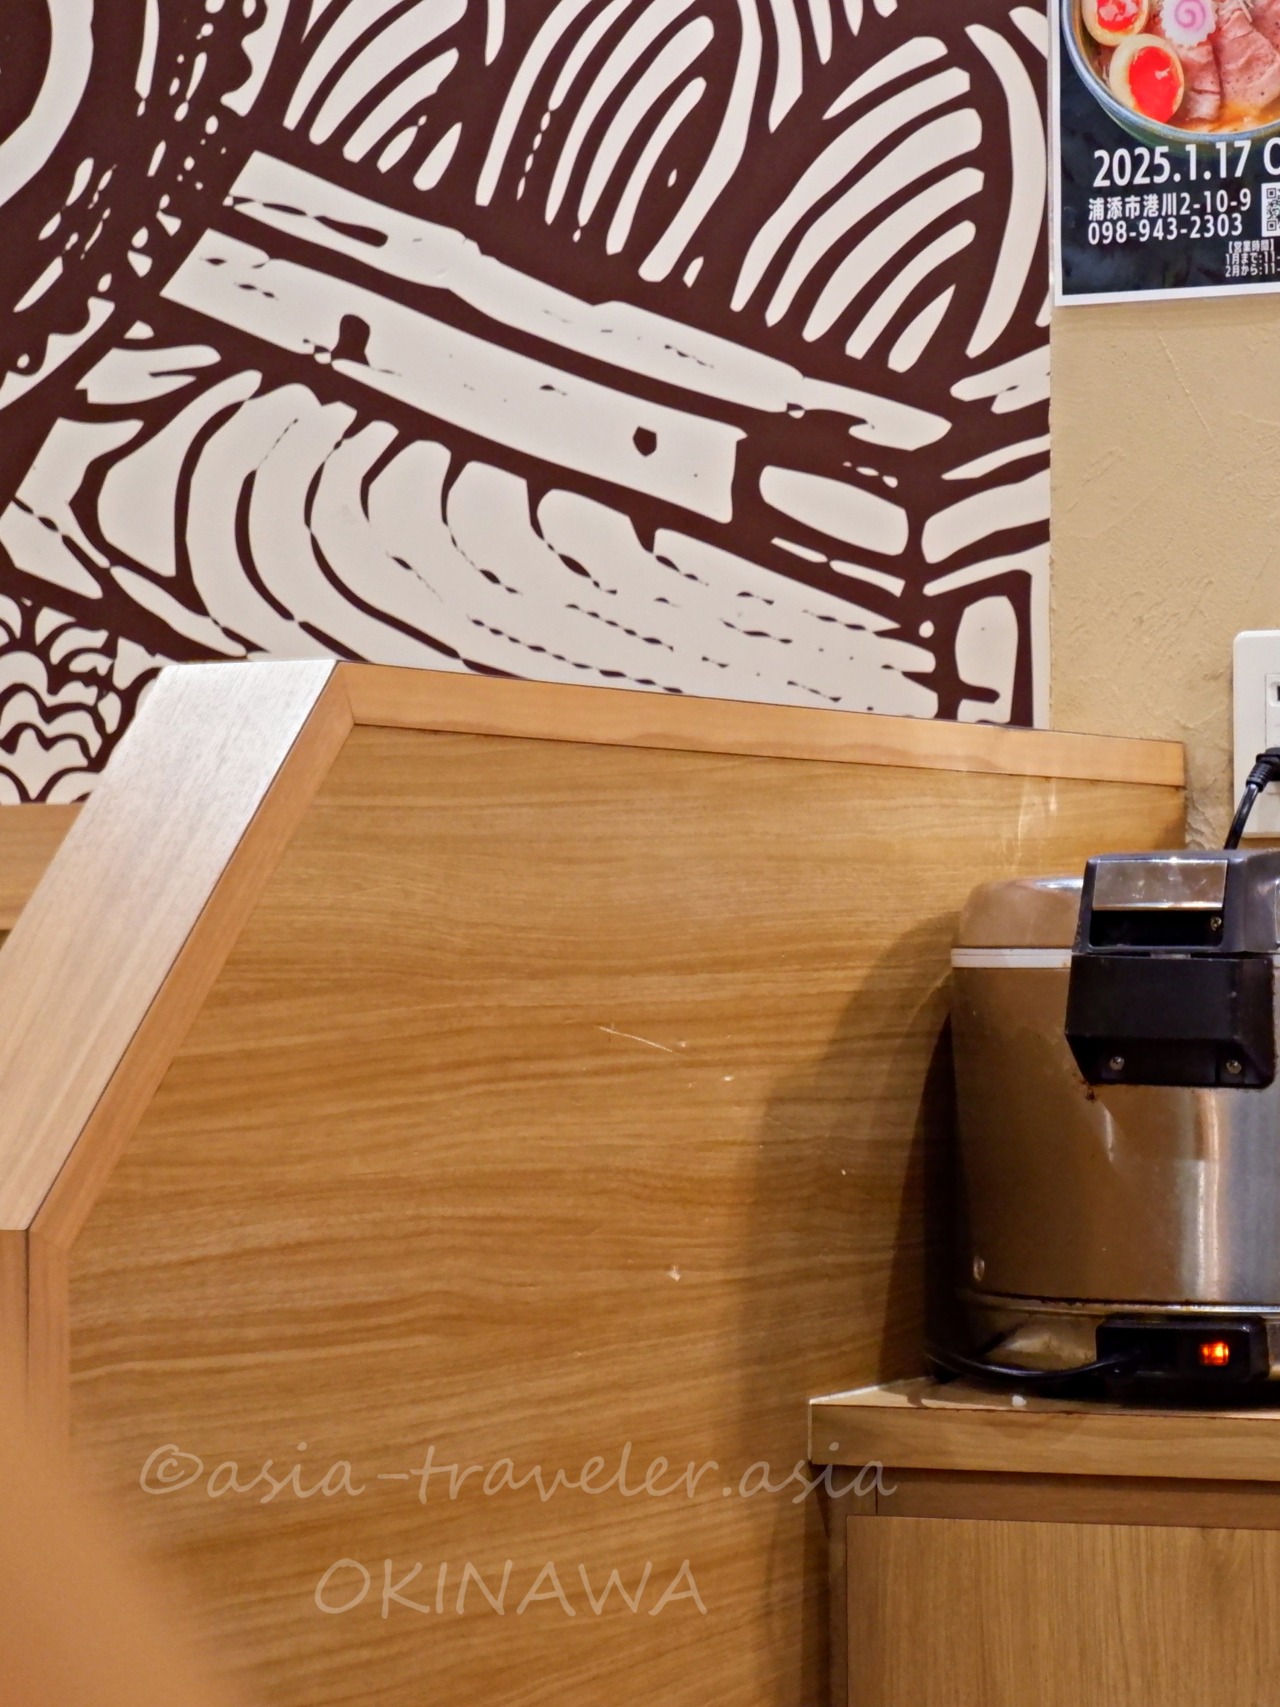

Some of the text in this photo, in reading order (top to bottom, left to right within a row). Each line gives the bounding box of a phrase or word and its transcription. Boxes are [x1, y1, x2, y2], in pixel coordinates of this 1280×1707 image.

[1093, 140, 1252, 187] 2025.1.17
[1088, 188, 1252, 221] 浦添市港川2-10-9
[1088, 213, 1243, 245] 098-943-2303
